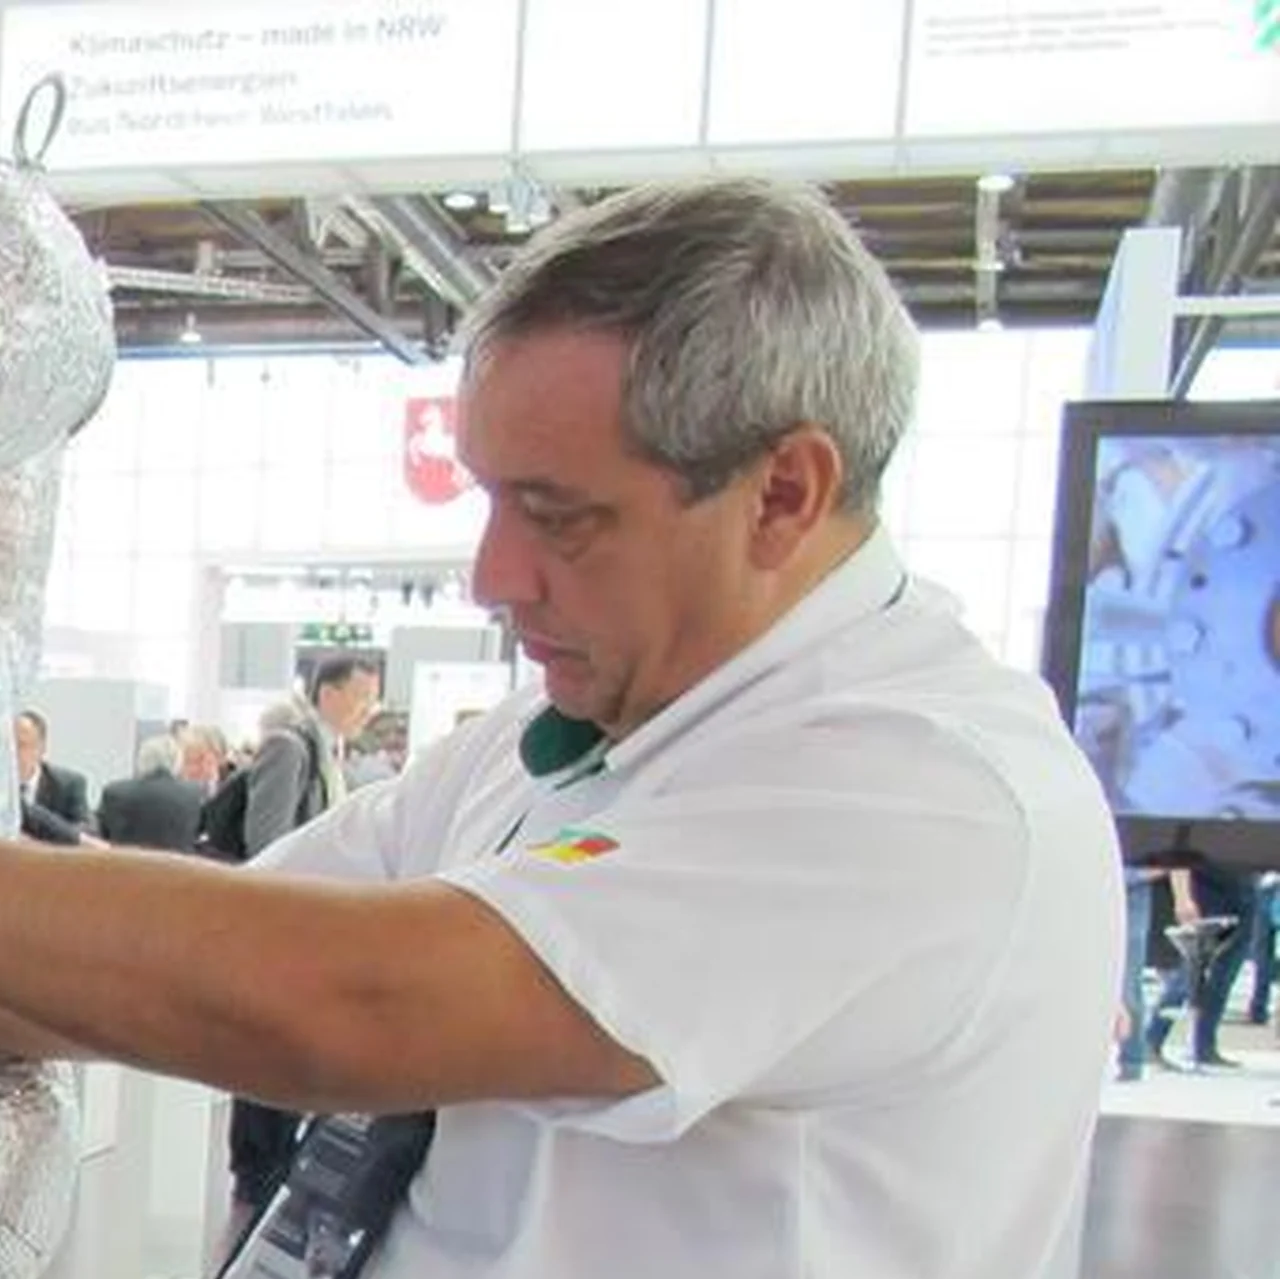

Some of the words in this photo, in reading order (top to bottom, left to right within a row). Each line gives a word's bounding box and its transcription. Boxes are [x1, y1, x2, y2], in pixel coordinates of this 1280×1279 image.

[68, 28, 231, 58] Klimaschutz
[261, 22, 335, 47] made
[343, 19, 369, 41] in
[376, 13, 448, 43] NRW
